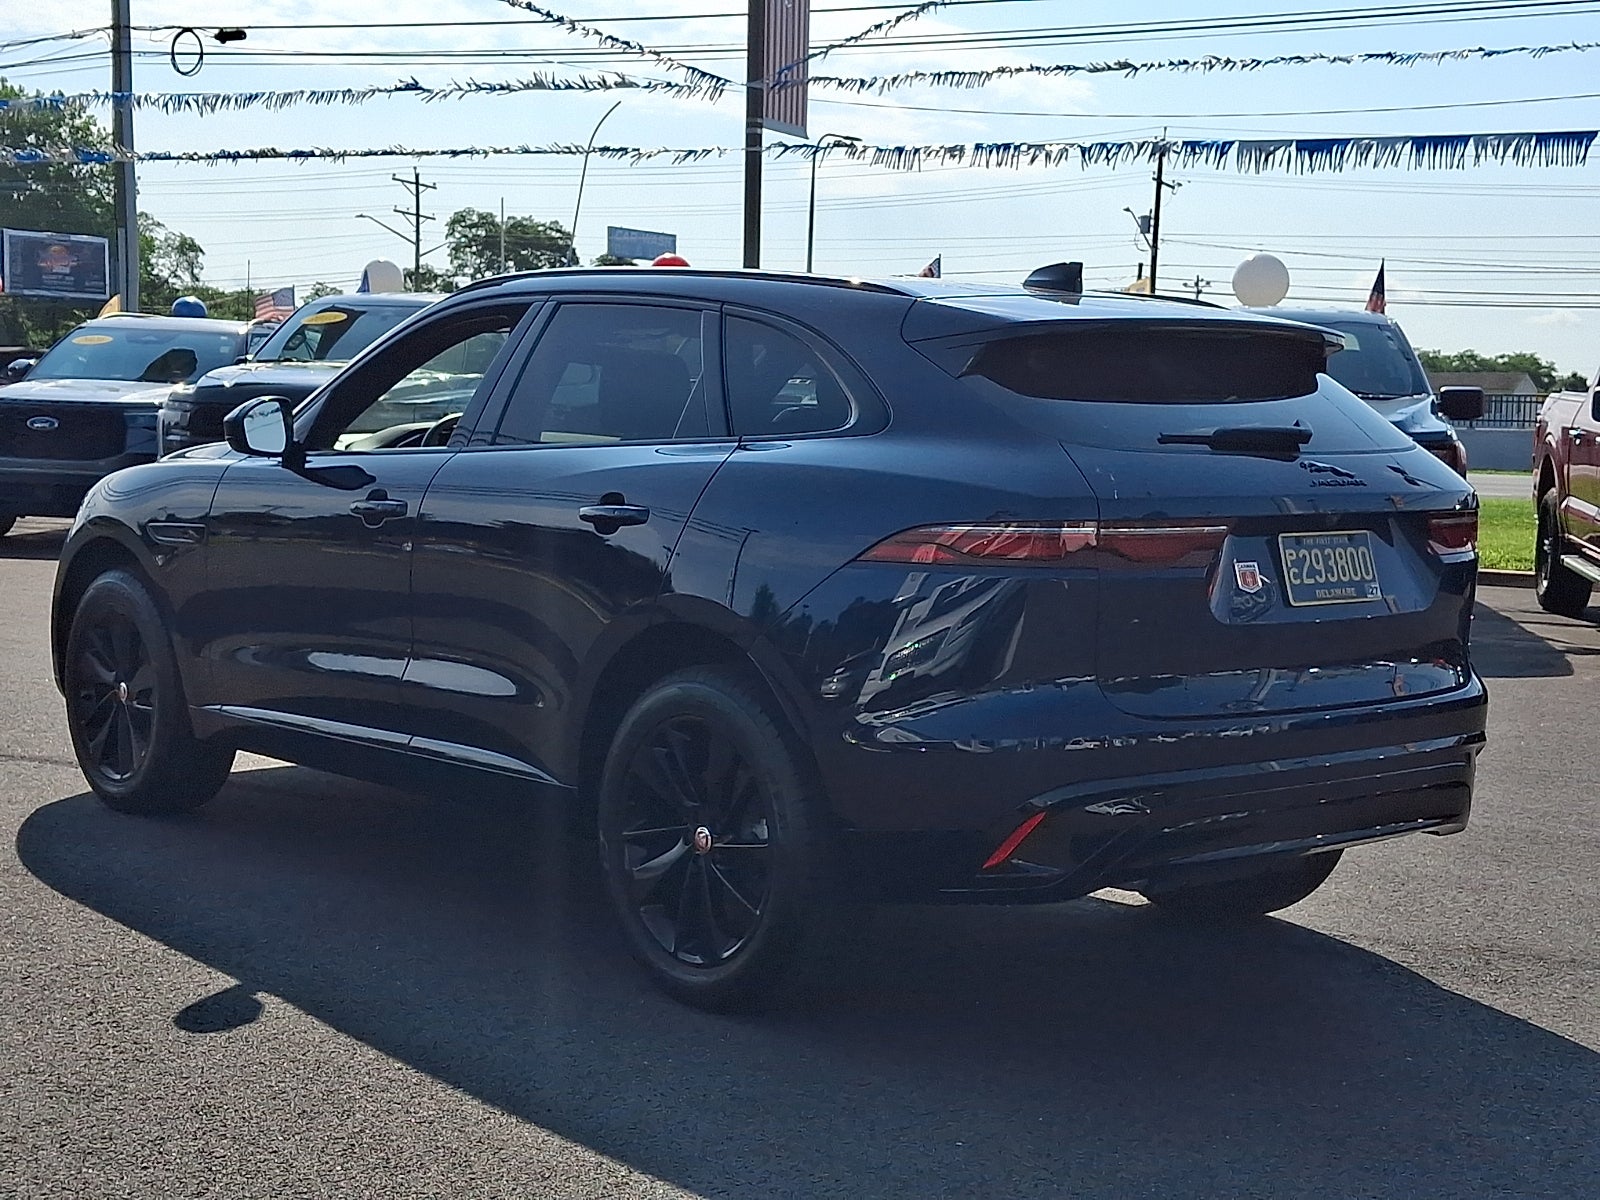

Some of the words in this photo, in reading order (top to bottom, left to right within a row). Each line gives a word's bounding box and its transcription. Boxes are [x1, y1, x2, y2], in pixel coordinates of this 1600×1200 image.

[1299, 546, 1373, 584] 293800
[1315, 587, 1357, 599] DELAWARE
[1369, 585, 1379, 596] 27
